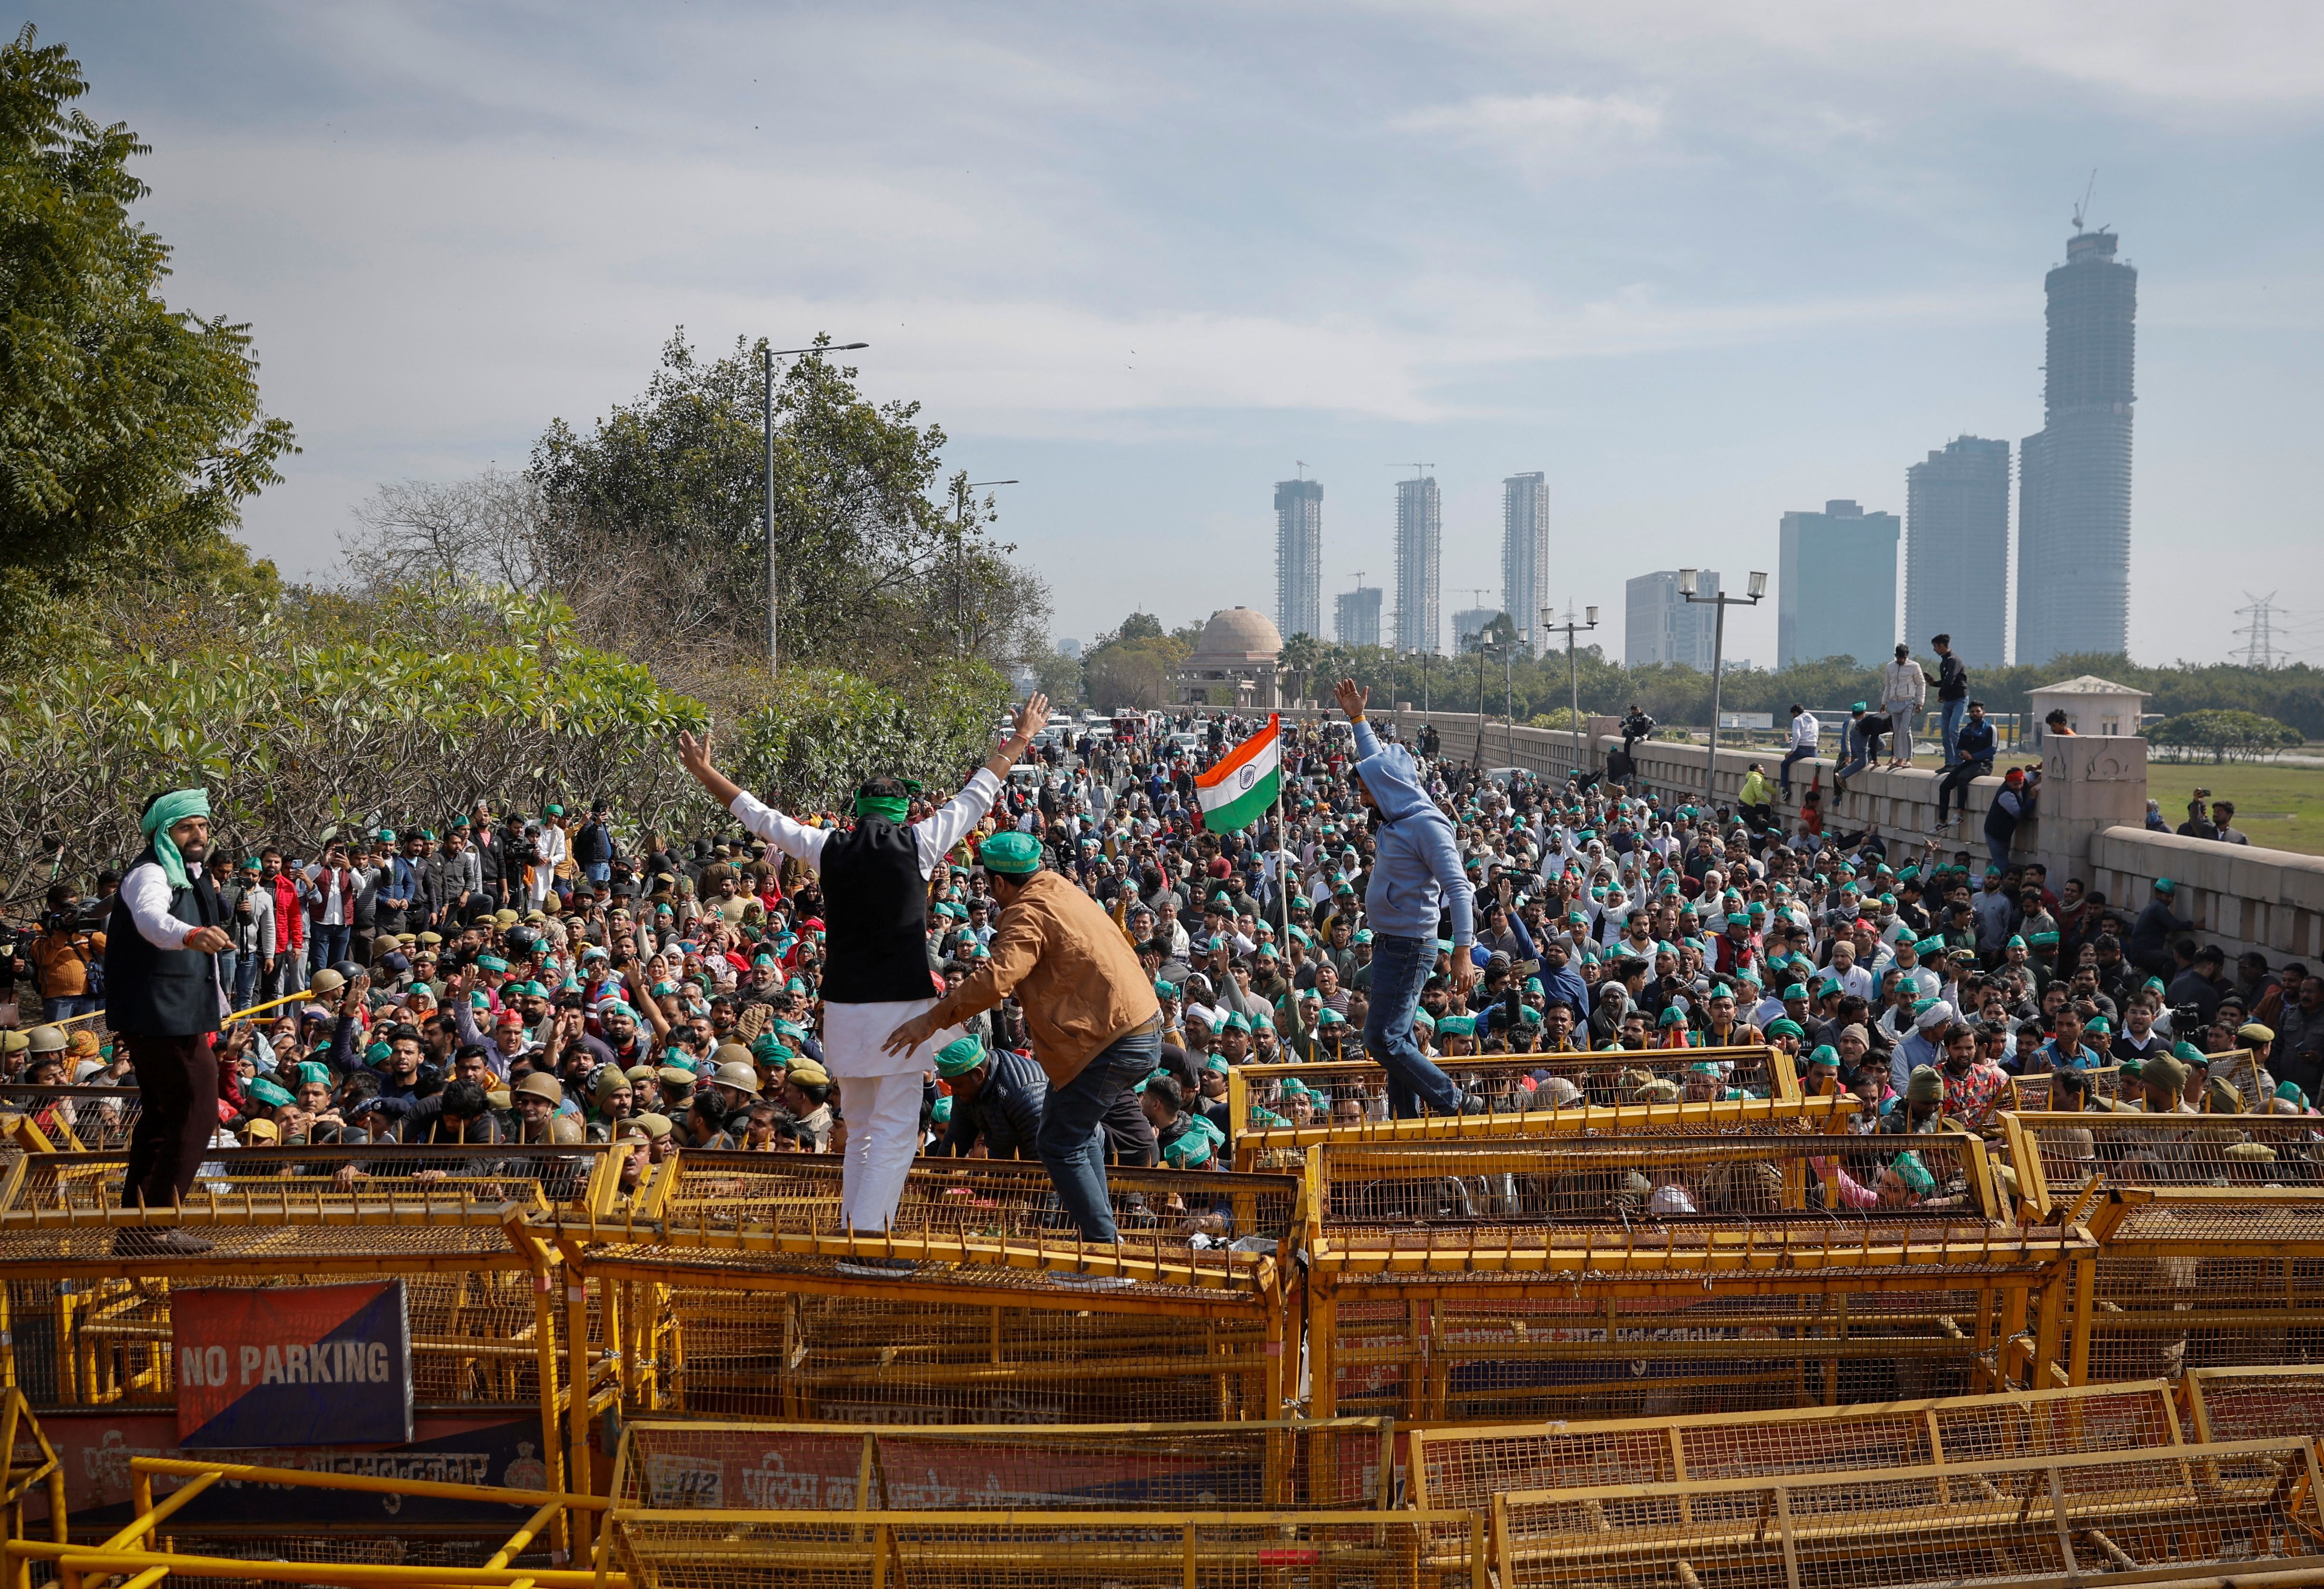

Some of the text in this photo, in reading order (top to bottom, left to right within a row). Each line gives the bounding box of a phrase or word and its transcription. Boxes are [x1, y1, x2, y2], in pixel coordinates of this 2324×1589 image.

[182, 1341, 389, 1386] NO PARKING
[679, 1472, 717, 1494] 112
